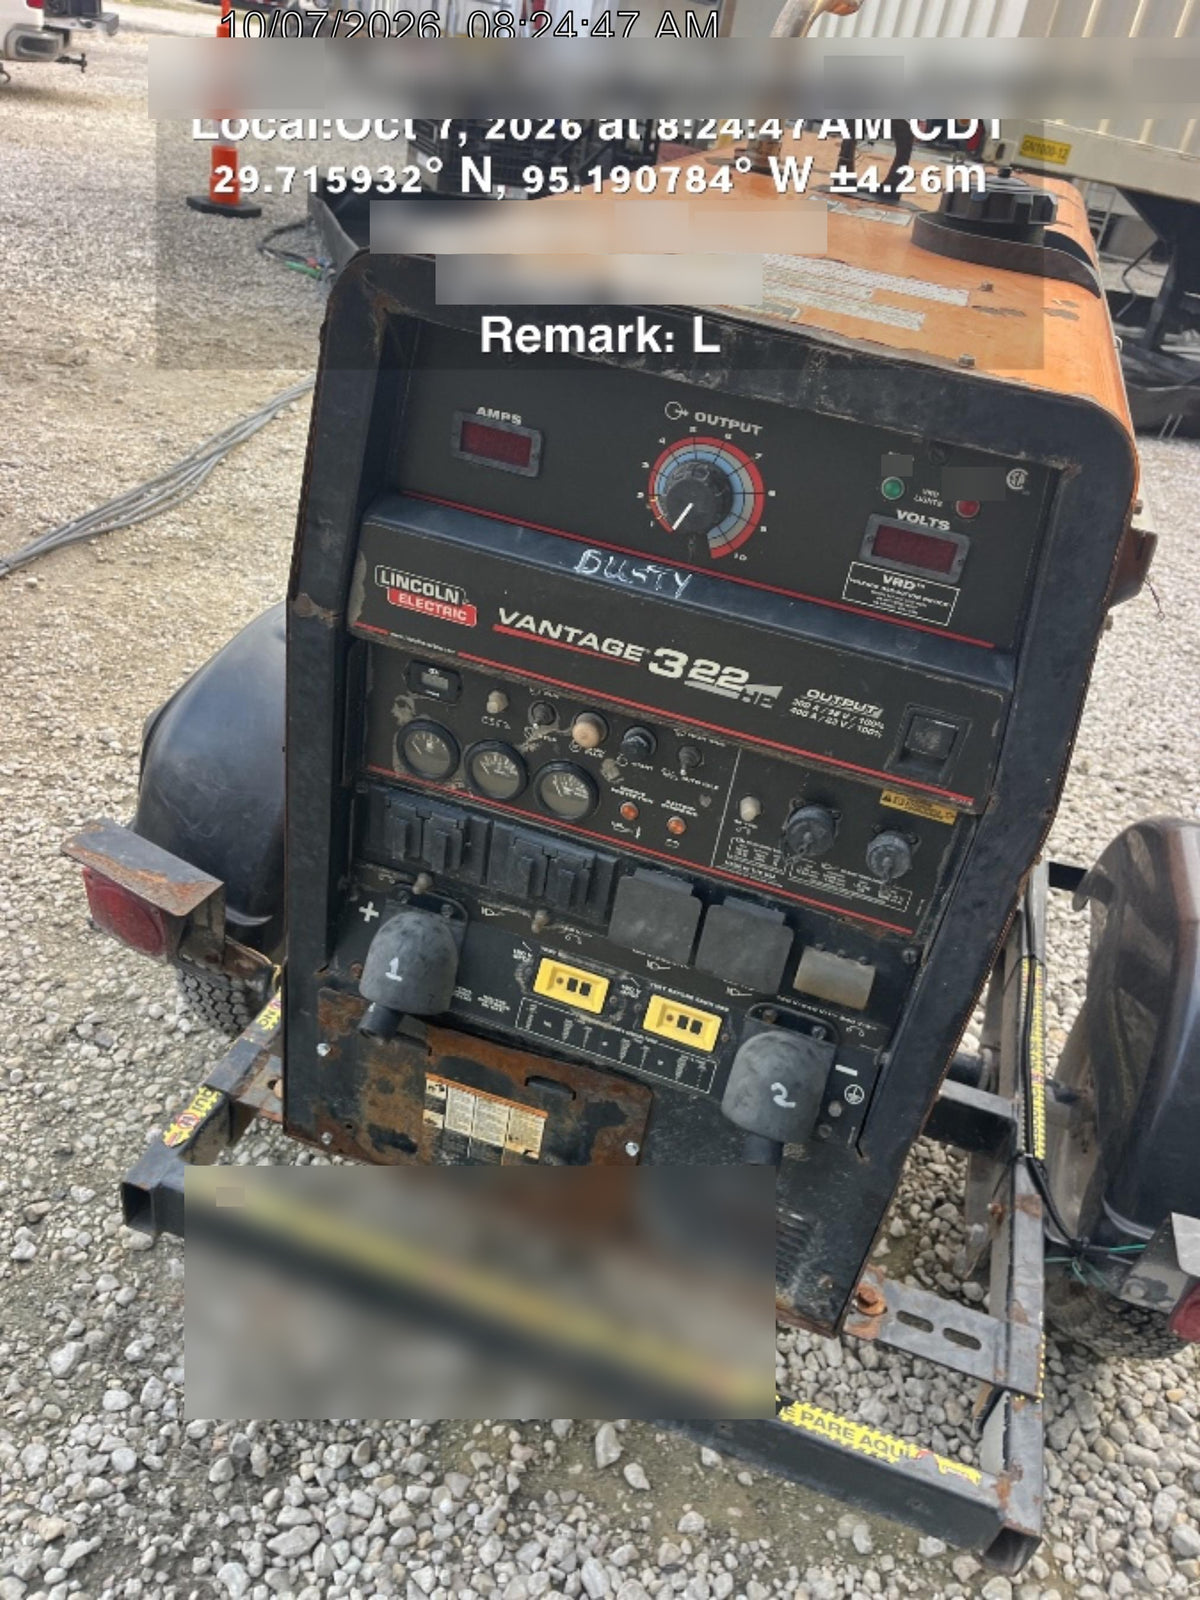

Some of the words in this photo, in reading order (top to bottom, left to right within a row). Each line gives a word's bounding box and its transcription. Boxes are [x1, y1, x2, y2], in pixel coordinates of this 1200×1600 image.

[475, 406, 522, 426] AMPS
[694, 411, 763, 436] OUTPUT
[896, 509, 951, 531] VOLTS
[381, 569, 461, 605] LINCOLN
[398, 592, 467, 622] ELECTRIC
[499, 607, 647, 663] VANTAGE
[648, 647, 750, 692] 322
[806, 688, 880, 714] OUTPUT
[385, 957, 403, 982] 1
[770, 1081, 796, 1109] 2
[800, 1410, 856, 1441] PARE
